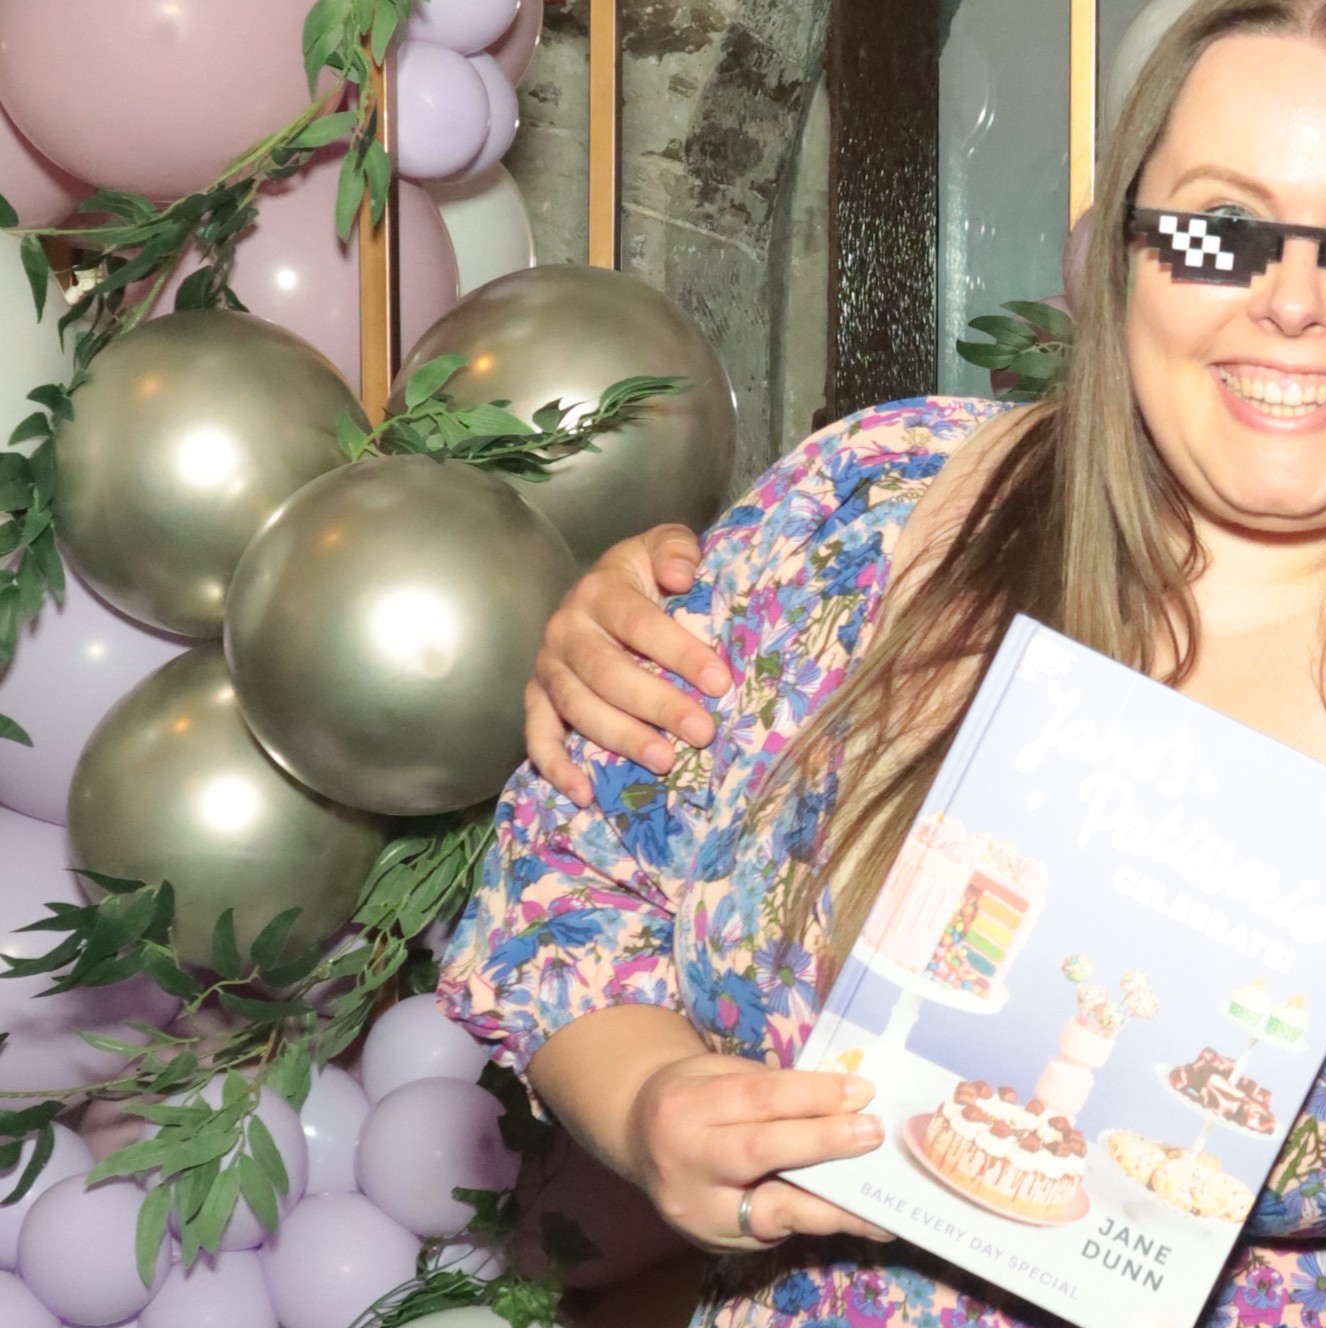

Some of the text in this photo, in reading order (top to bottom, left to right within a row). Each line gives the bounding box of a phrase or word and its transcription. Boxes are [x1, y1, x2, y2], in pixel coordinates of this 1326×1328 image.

[1112, 867, 1297, 974] CELEBRATE!
[859, 1181, 1080, 1301] BAKE EVERY DAY SPECIAL
[1081, 1239, 1164, 1292] DUNN
[1098, 1217, 1172, 1266] JANE
